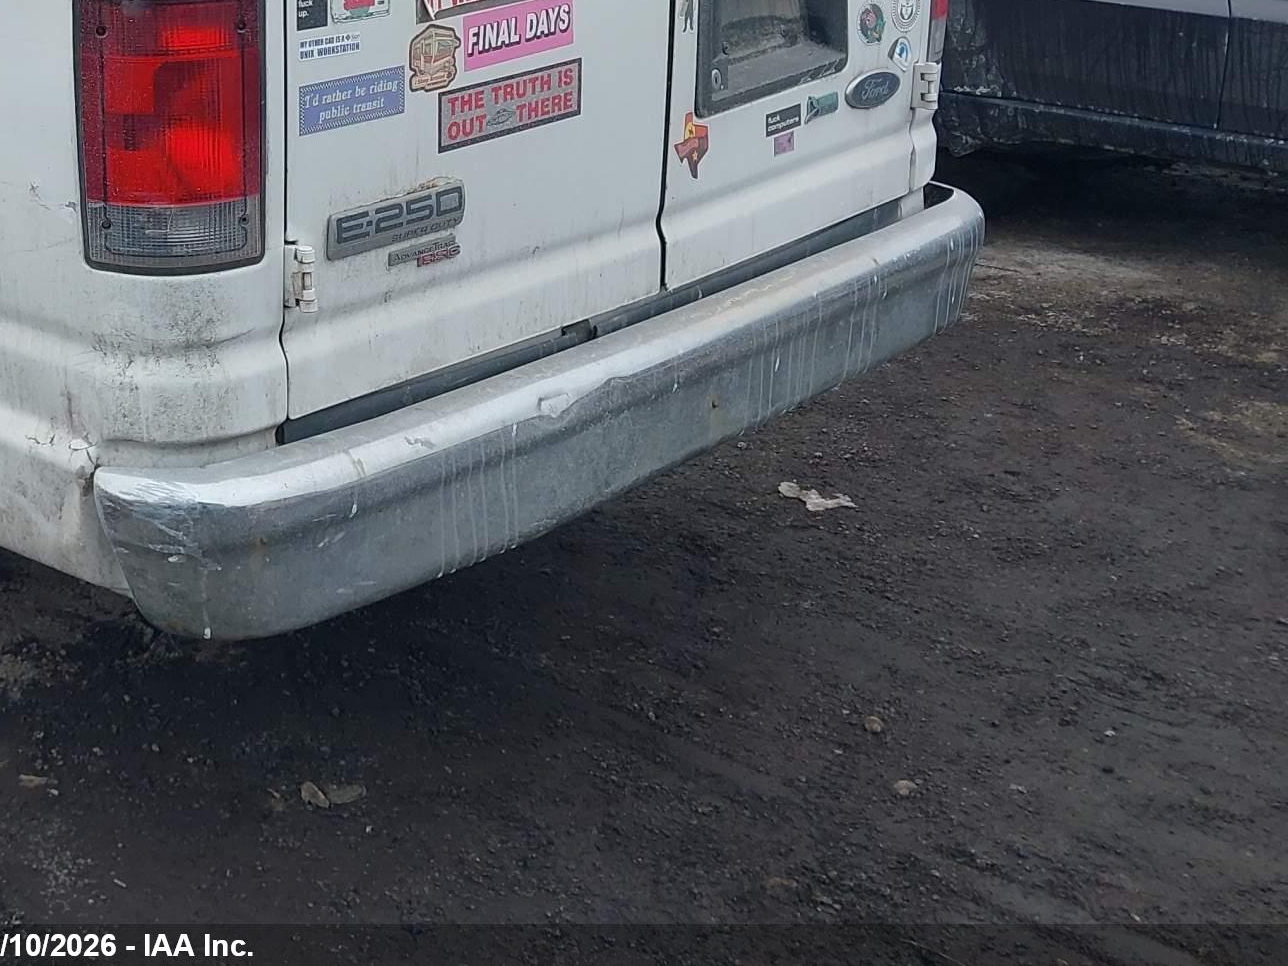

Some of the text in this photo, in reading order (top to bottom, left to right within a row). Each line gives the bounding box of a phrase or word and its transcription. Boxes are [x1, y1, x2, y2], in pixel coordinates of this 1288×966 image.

[298, 0, 313, 8] fuck
[298, 10, 309, 19] up.
[467, 3, 571, 57] FINAL DAYS
[300, 41, 360, 60] UNIX WORKSTATION
[304, 79, 400, 109] I'd rather be riding
[447, 67, 574, 116] THE TRUTH IS
[861, 78, 889, 100] Ford
[319, 96, 385, 124] public transit
[447, 90, 574, 141] OUT THERE
[767, 115, 800, 133] computers
[392, 217, 459, 242] SUPER DUTY
